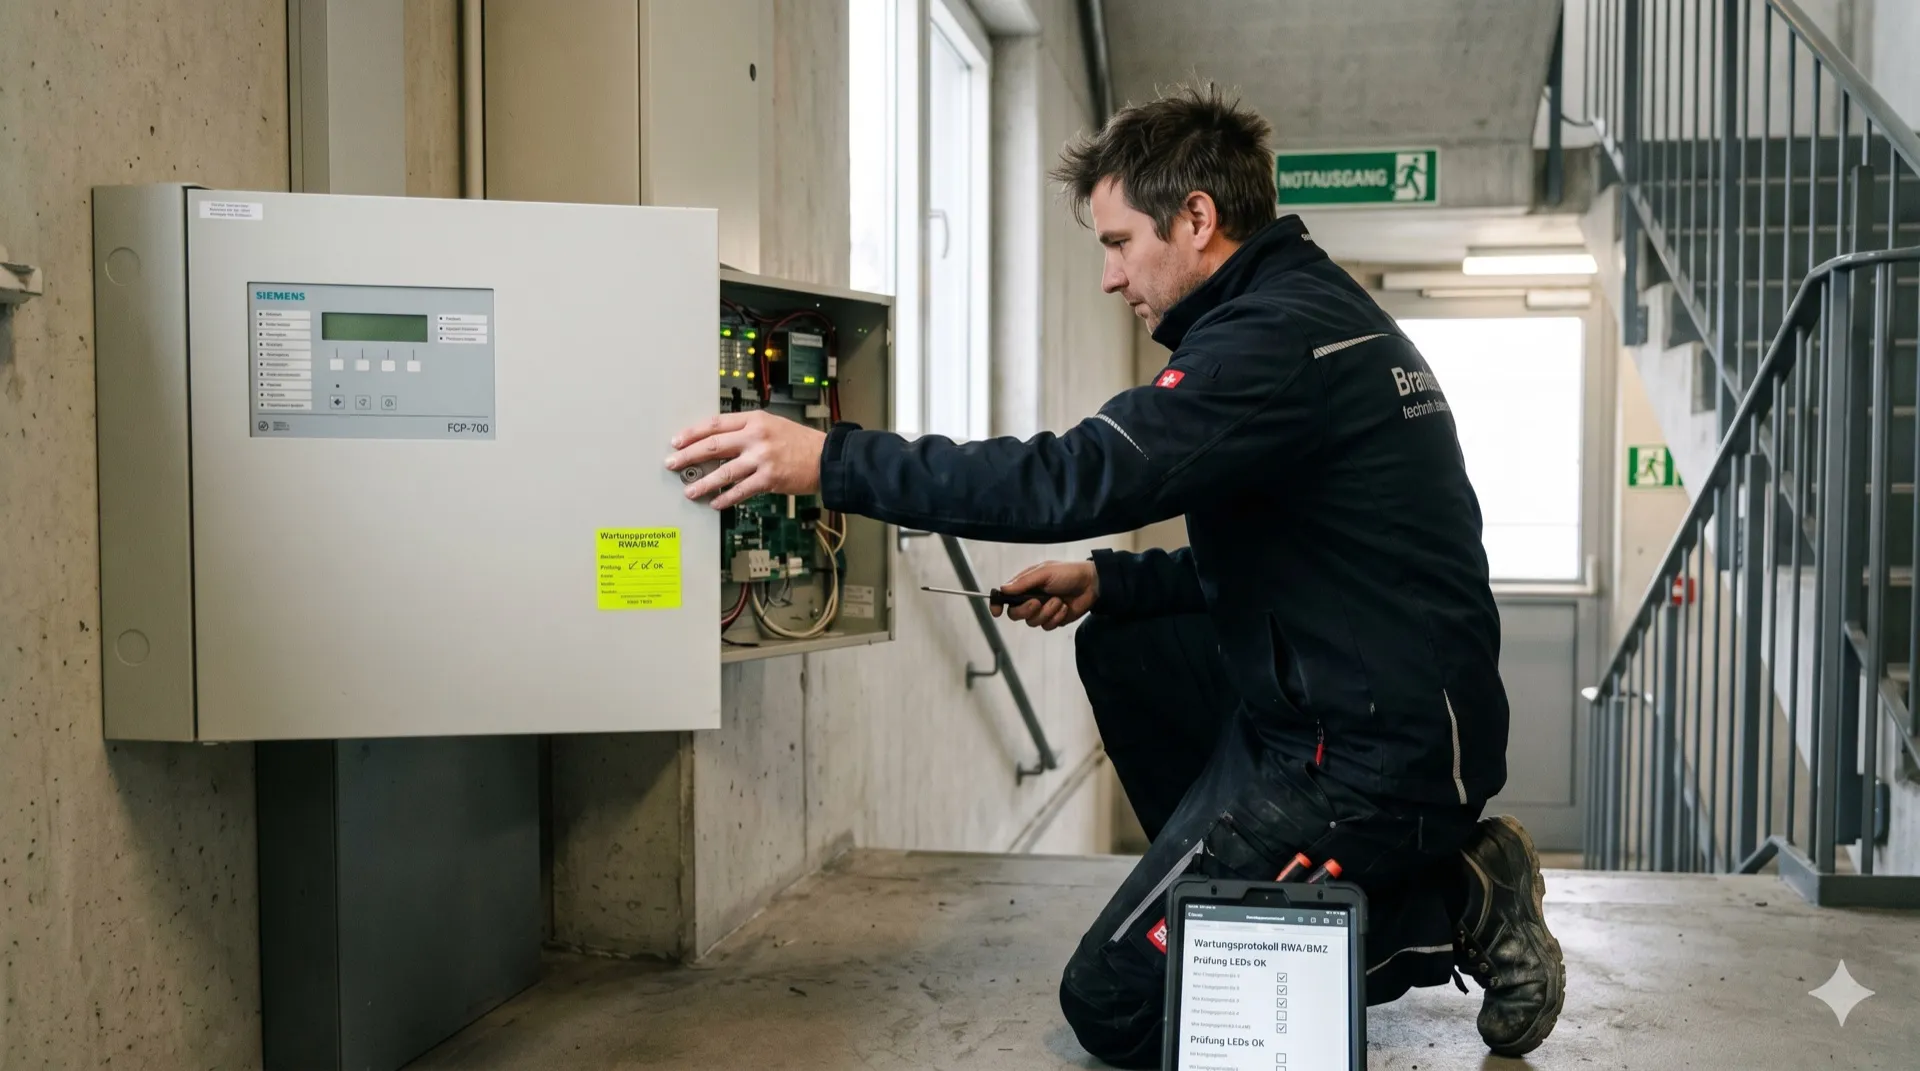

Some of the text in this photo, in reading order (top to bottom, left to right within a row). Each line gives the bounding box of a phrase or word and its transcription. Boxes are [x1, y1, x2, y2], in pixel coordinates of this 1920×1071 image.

[1278, 168, 1387, 189] NOTAUSGANG
[256, 291, 306, 301] SIEMENS
[447, 422, 489, 433] FCP-700
[1194, 938, 1328, 954] Wartungsprotokoll RWA/BMZ
[1193, 955, 1267, 968] Prüfung LEDs OK
[1190, 1035, 1265, 1048] Prüfung LEDs OK
